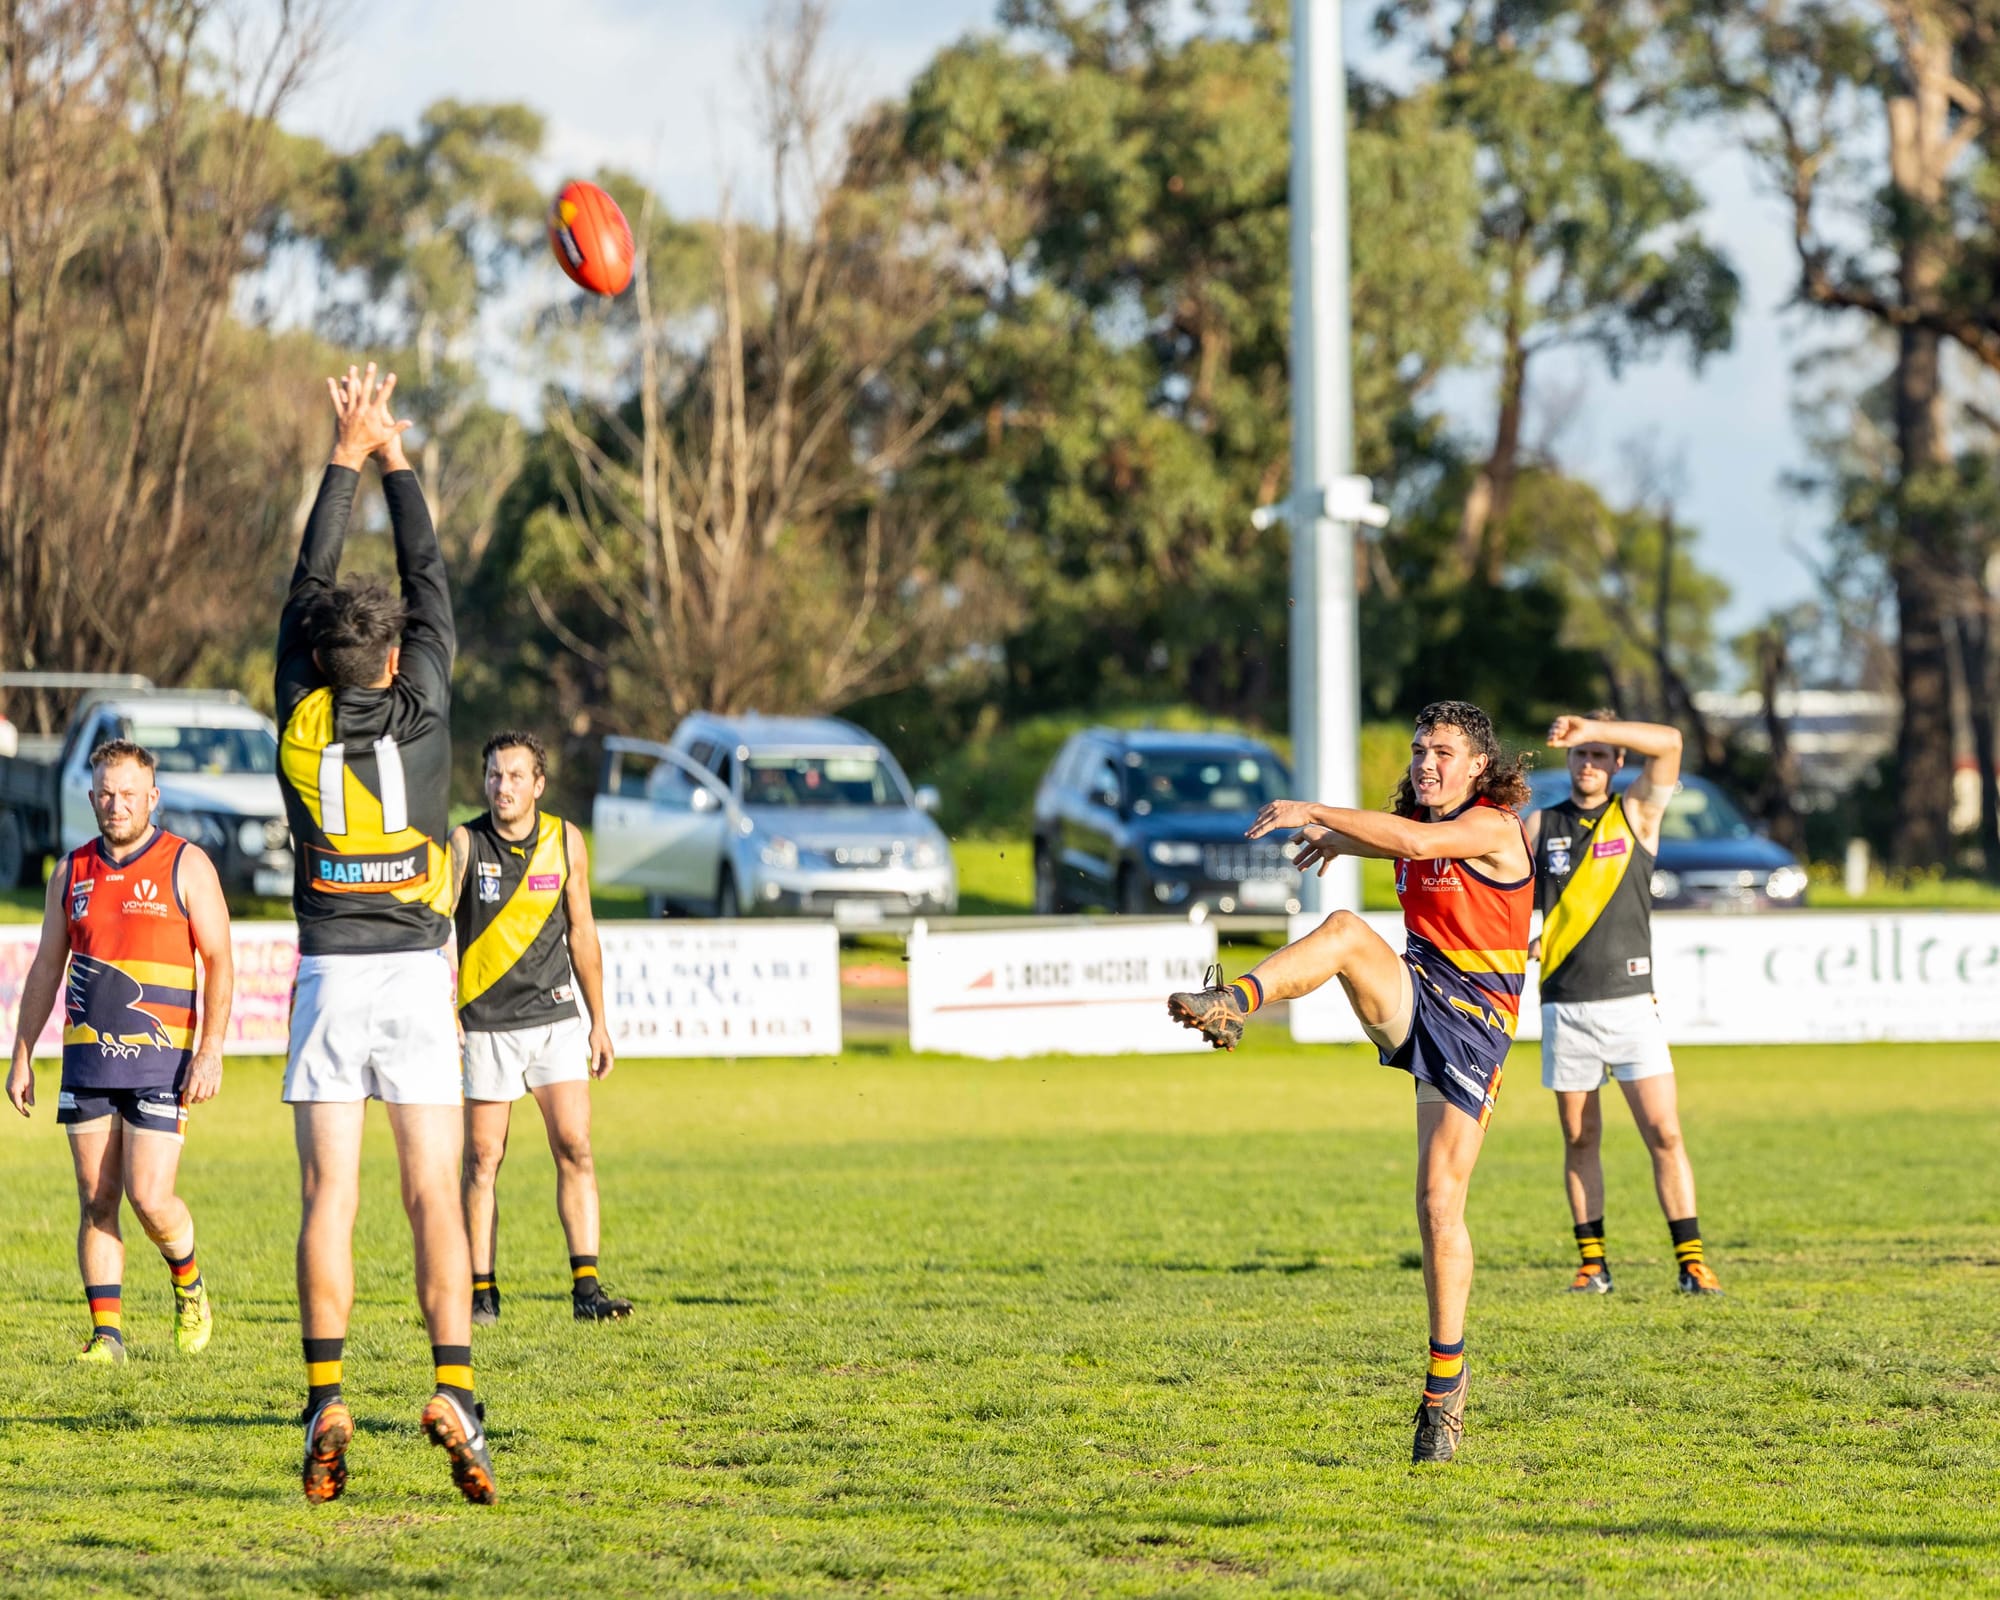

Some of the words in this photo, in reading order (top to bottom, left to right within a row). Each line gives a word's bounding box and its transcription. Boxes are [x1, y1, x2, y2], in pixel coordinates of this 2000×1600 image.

[319, 734, 409, 836] 11
[319, 856, 416, 883] BARWICK
[122, 900, 168, 913] VOYAGE
